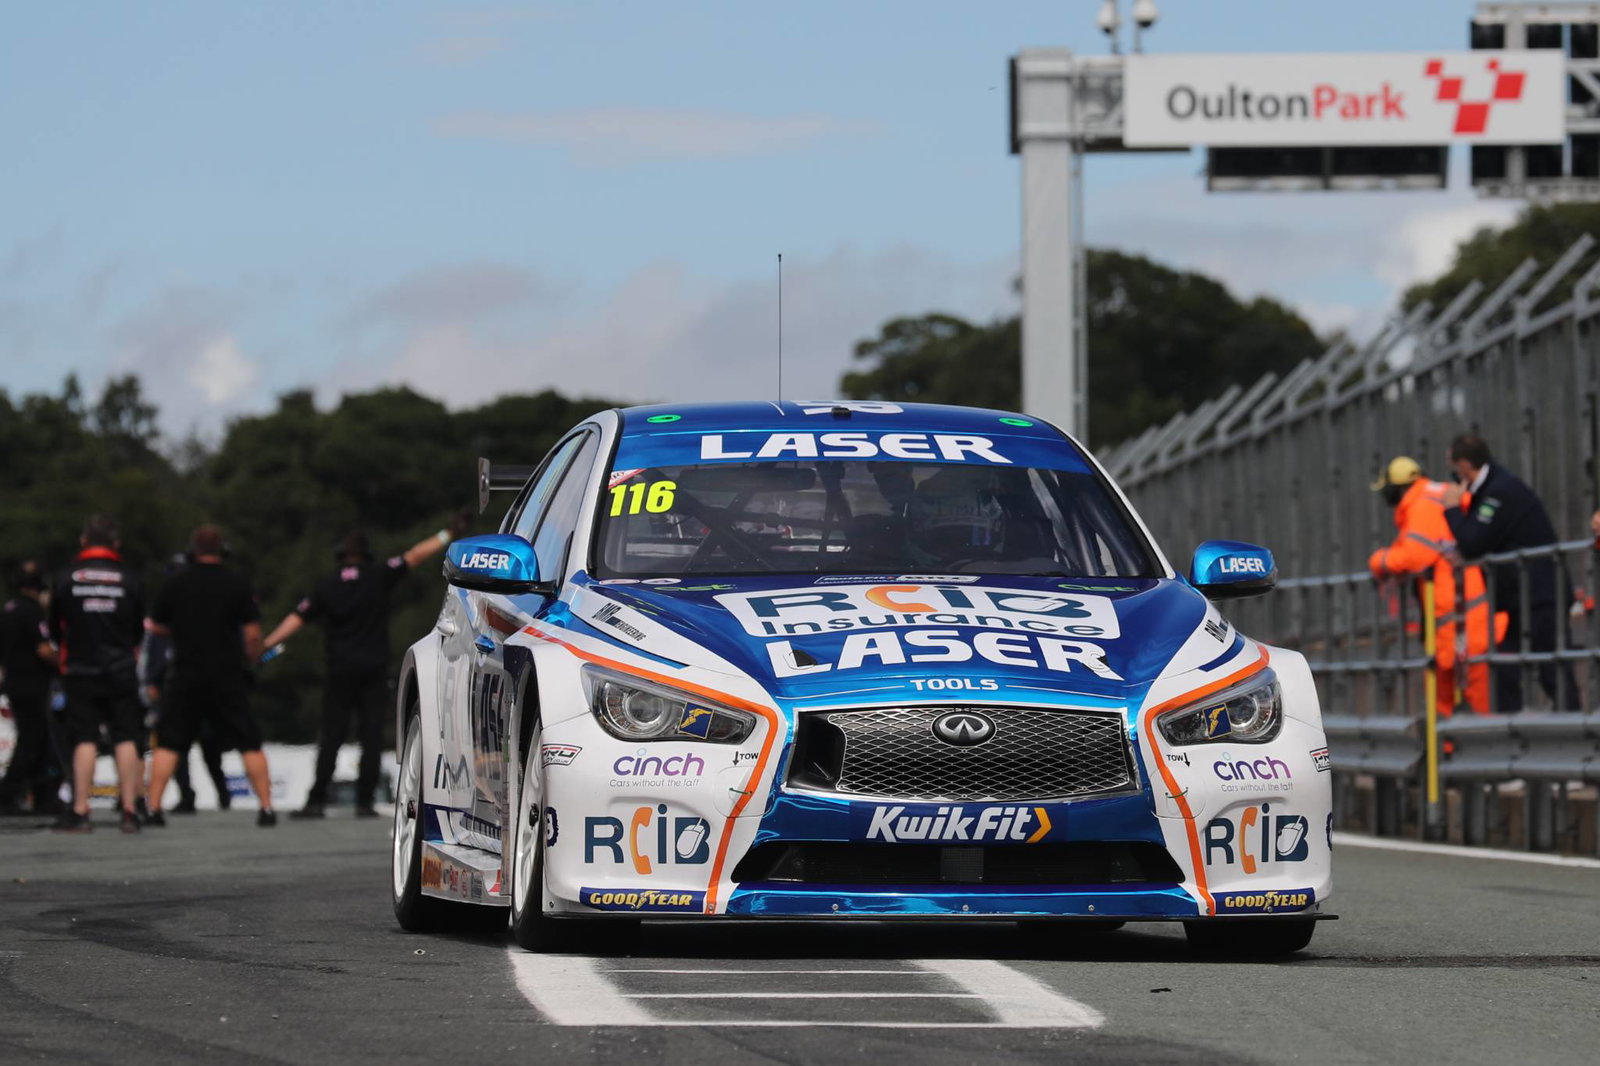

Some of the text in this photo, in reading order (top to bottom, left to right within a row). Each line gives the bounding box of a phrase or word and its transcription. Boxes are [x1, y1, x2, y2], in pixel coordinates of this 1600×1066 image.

[700, 433, 1014, 463] LASER
[610, 480, 677, 517] 116
[461, 553, 509, 570] LASER
[1219, 557, 1266, 573] LASER
[766, 630, 1125, 681] LASER
[910, 678, 999, 691] TOOLS
[613, 748, 704, 776] cinch
[740, 752, 759, 760] TOW
[1166, 754, 1184, 762] TOW
[1213, 752, 1291, 781] cinch
[609, 779, 630, 788] Cars
[632, 778, 665, 787] without
[668, 777, 682, 787] the
[1221, 784, 1239, 792] Cars
[1240, 783, 1266, 792] without
